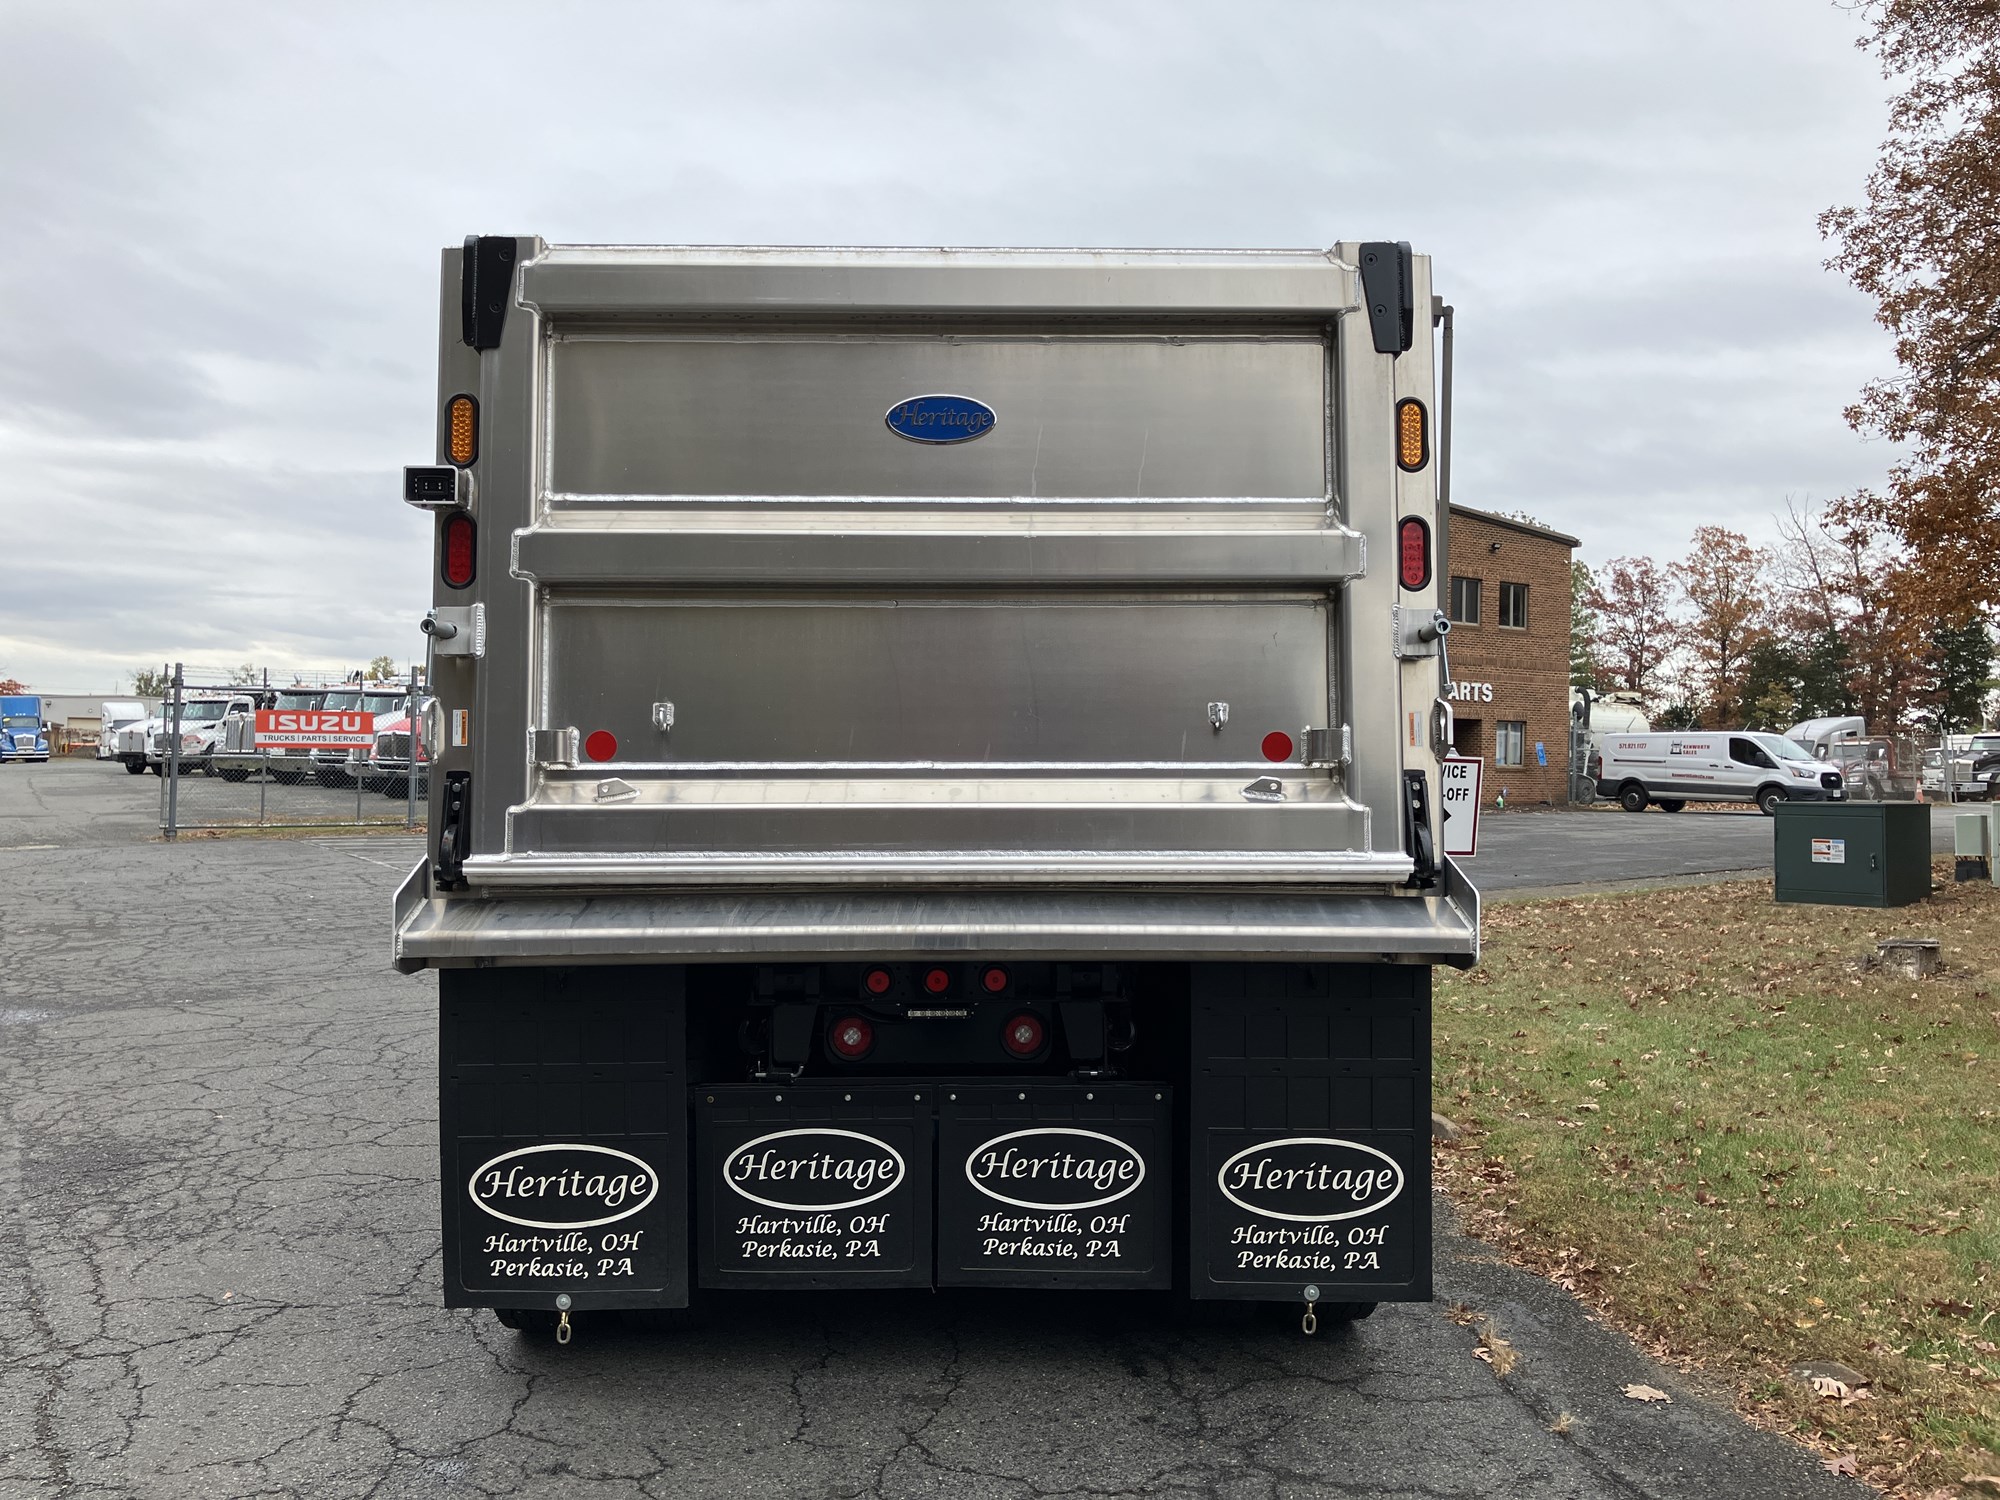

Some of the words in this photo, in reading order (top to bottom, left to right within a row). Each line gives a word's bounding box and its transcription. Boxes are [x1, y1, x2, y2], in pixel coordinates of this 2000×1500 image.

[893, 401, 991, 433] Heritage
[269, 714, 361, 731] ISUZU
[263, 734, 296, 742] TRUCKS
[333, 735, 366, 743] SERVICE
[734, 1150, 895, 1189] Heritage
[977, 1148, 1133, 1189] Heritage
[1230, 1159, 1392, 1200] Heritage
[481, 1166, 646, 1206] Heritage
[736, 1214, 841, 1236] Hartville,
[850, 1214, 890, 1233] OH
[977, 1212, 1082, 1235] Hartville,
[1091, 1214, 1130, 1233] OH
[483, 1232, 592, 1254] Hartville,
[602, 1231, 643, 1251] OH
[1231, 1225, 1339, 1247] Hartville,
[1348, 1225, 1389, 1245] OH
[742, 1239, 837, 1259] Perkasie,
[846, 1240, 881, 1257] PA
[983, 1238, 1077, 1259] Perkasie,
[1086, 1240, 1121, 1257] PA
[490, 1257, 588, 1279] Perkasie,
[597, 1258, 634, 1276] PA
[1238, 1249, 1335, 1271] Perkasie,
[1344, 1252, 1380, 1269] PA
